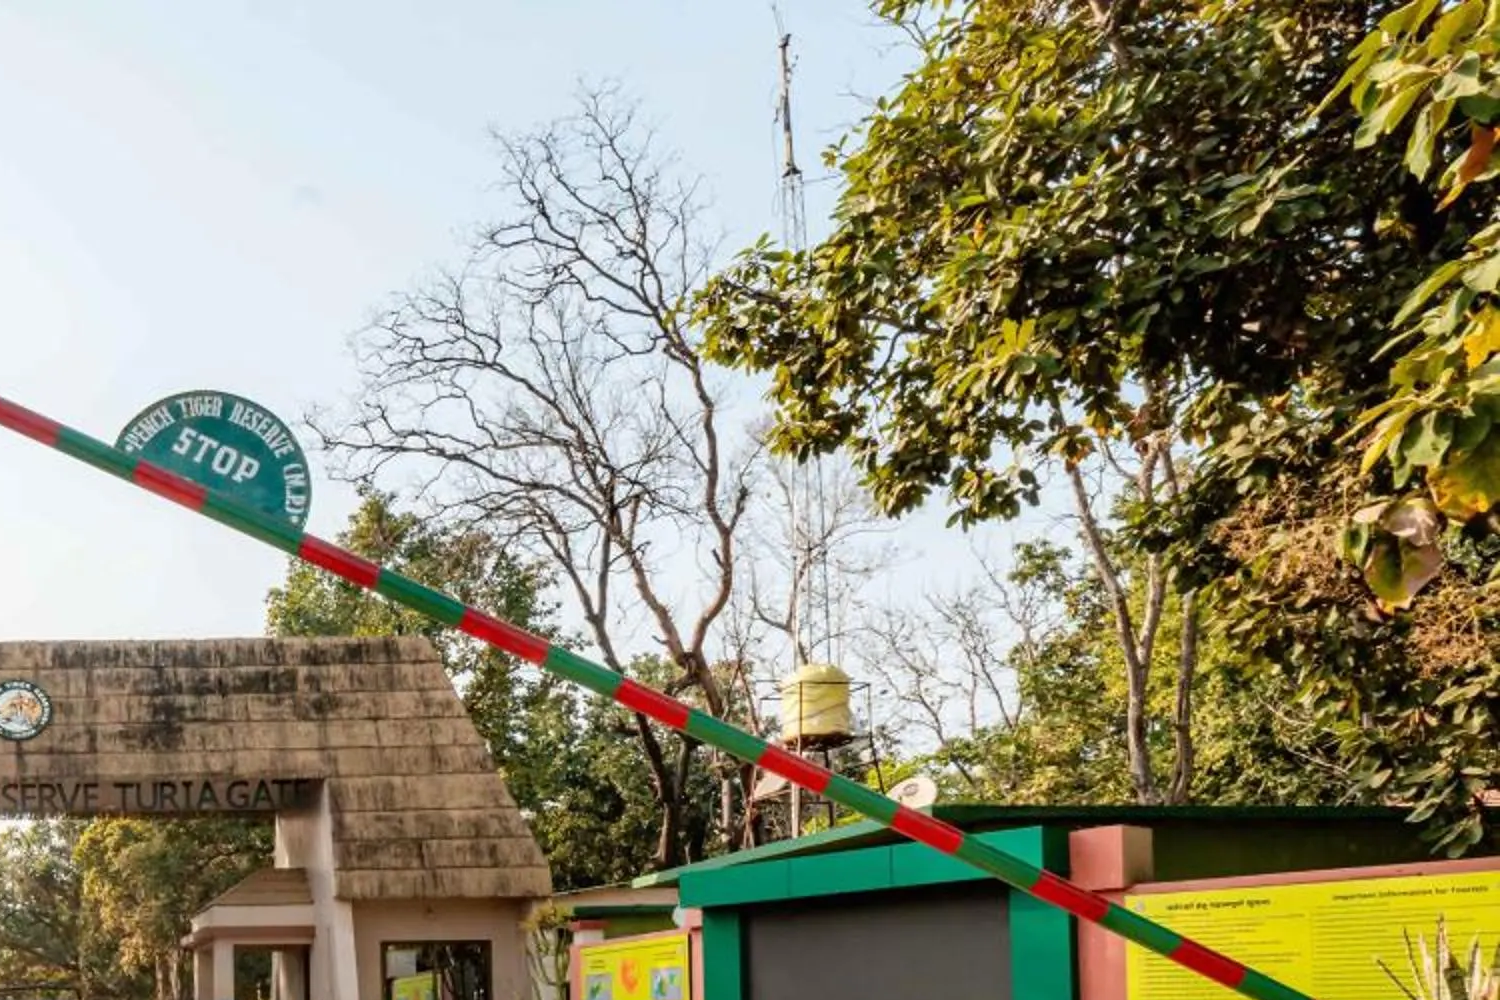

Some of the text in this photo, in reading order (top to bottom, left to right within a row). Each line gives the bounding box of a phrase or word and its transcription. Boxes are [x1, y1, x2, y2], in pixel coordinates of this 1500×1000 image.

[126, 403, 176, 451] PENCH
[176, 395, 225, 419] TIGER
[228, 401, 295, 459] RESERVE
[171, 426, 261, 484] STOP
[113, 778, 219, 811] TURIA
